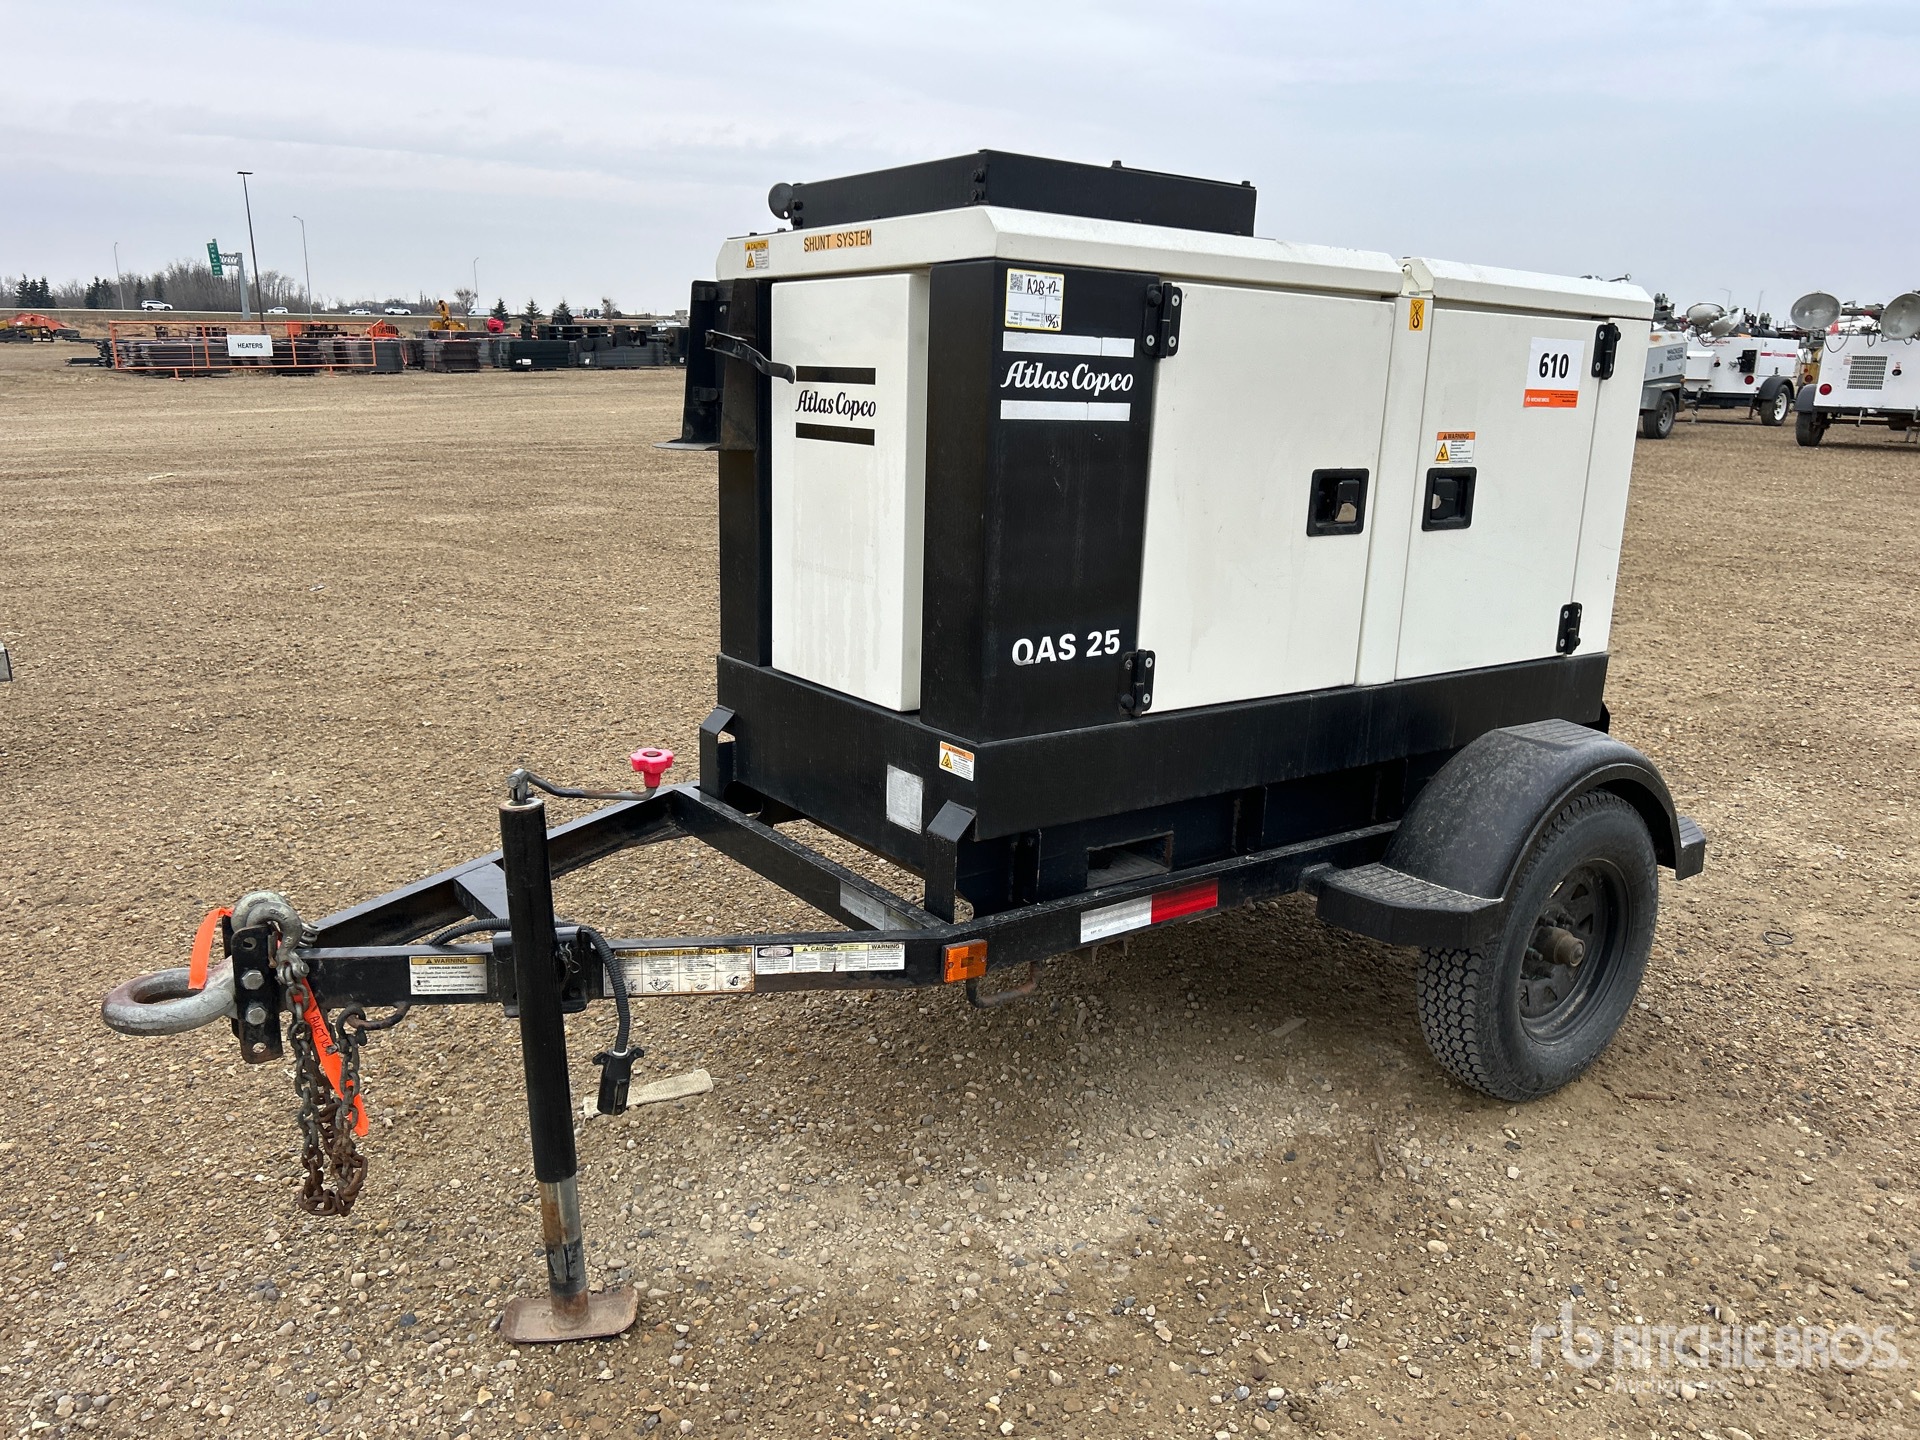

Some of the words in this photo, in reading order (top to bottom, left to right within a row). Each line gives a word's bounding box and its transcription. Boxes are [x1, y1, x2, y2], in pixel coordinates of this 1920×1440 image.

[751, 242, 767, 250] CAUTION
[803, 234, 832, 253] SHUNT
[836, 228, 872, 248] SYSTEM
[1000, 360, 1070, 390] Atlas
[1071, 363, 1134, 396] Copco
[1538, 352, 1569, 379] 610
[795, 389, 834, 414] Atlas
[836, 391, 876, 421] Copco
[1011, 633, 1076, 666] QAS
[1085, 629, 1120, 657] 25
